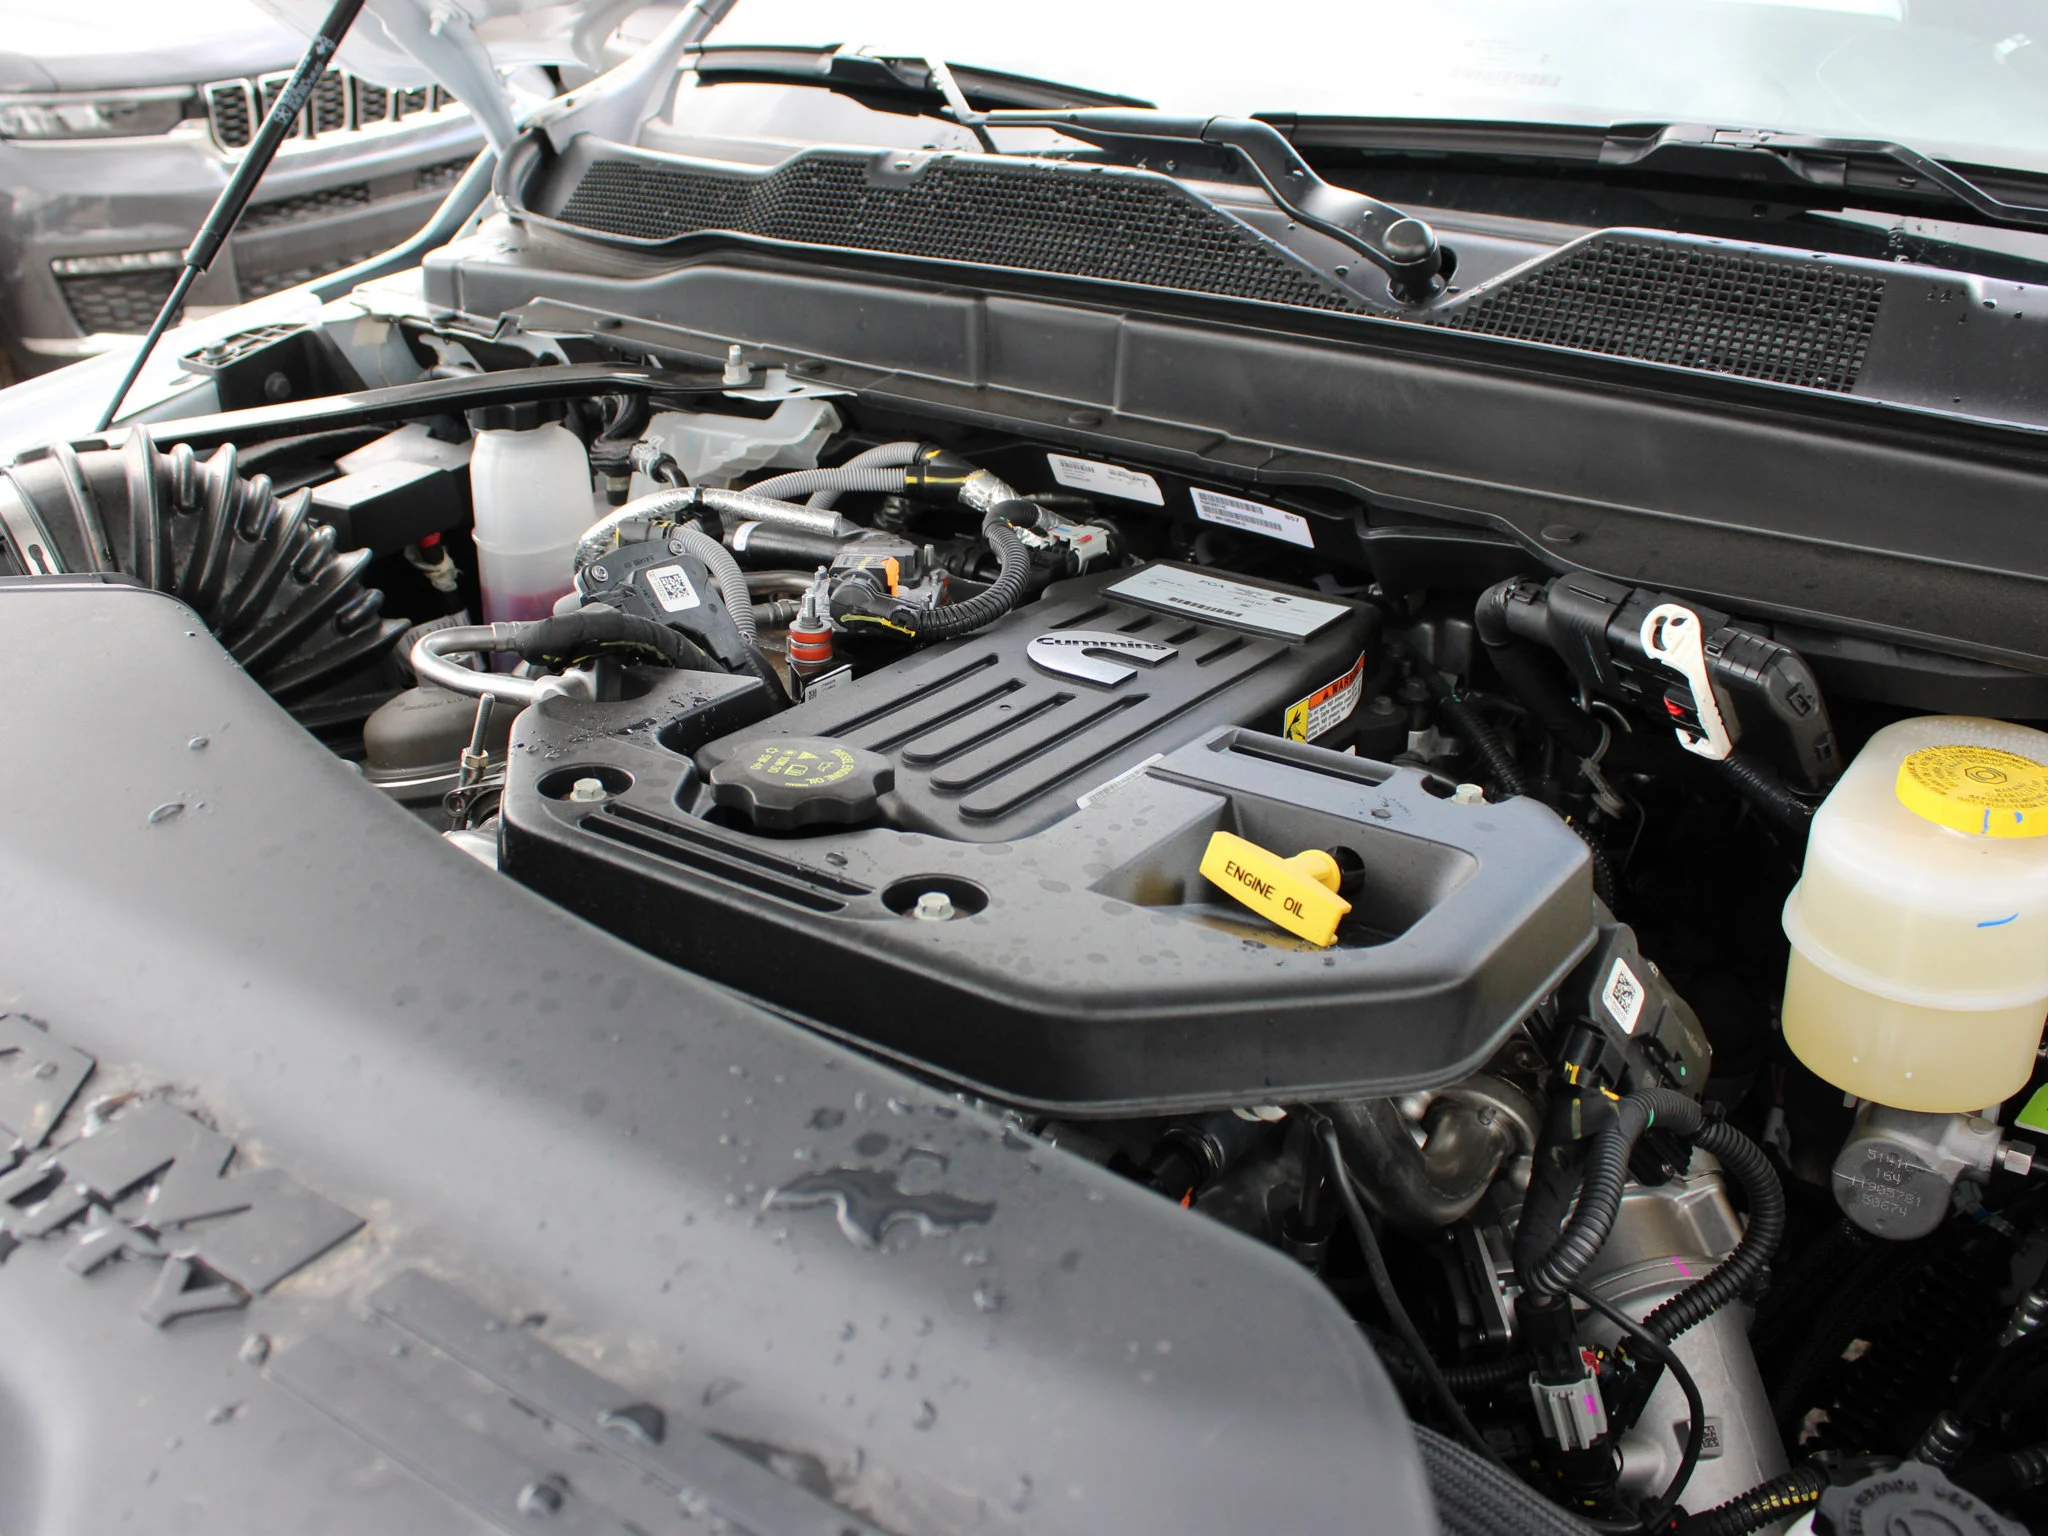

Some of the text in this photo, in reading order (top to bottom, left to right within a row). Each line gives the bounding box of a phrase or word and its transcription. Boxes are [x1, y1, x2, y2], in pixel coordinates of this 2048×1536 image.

[1036, 637, 1168, 650] Cummins
[804, 777, 825, 785] OIL
[1224, 860, 1305, 920] ENGINE OIL
